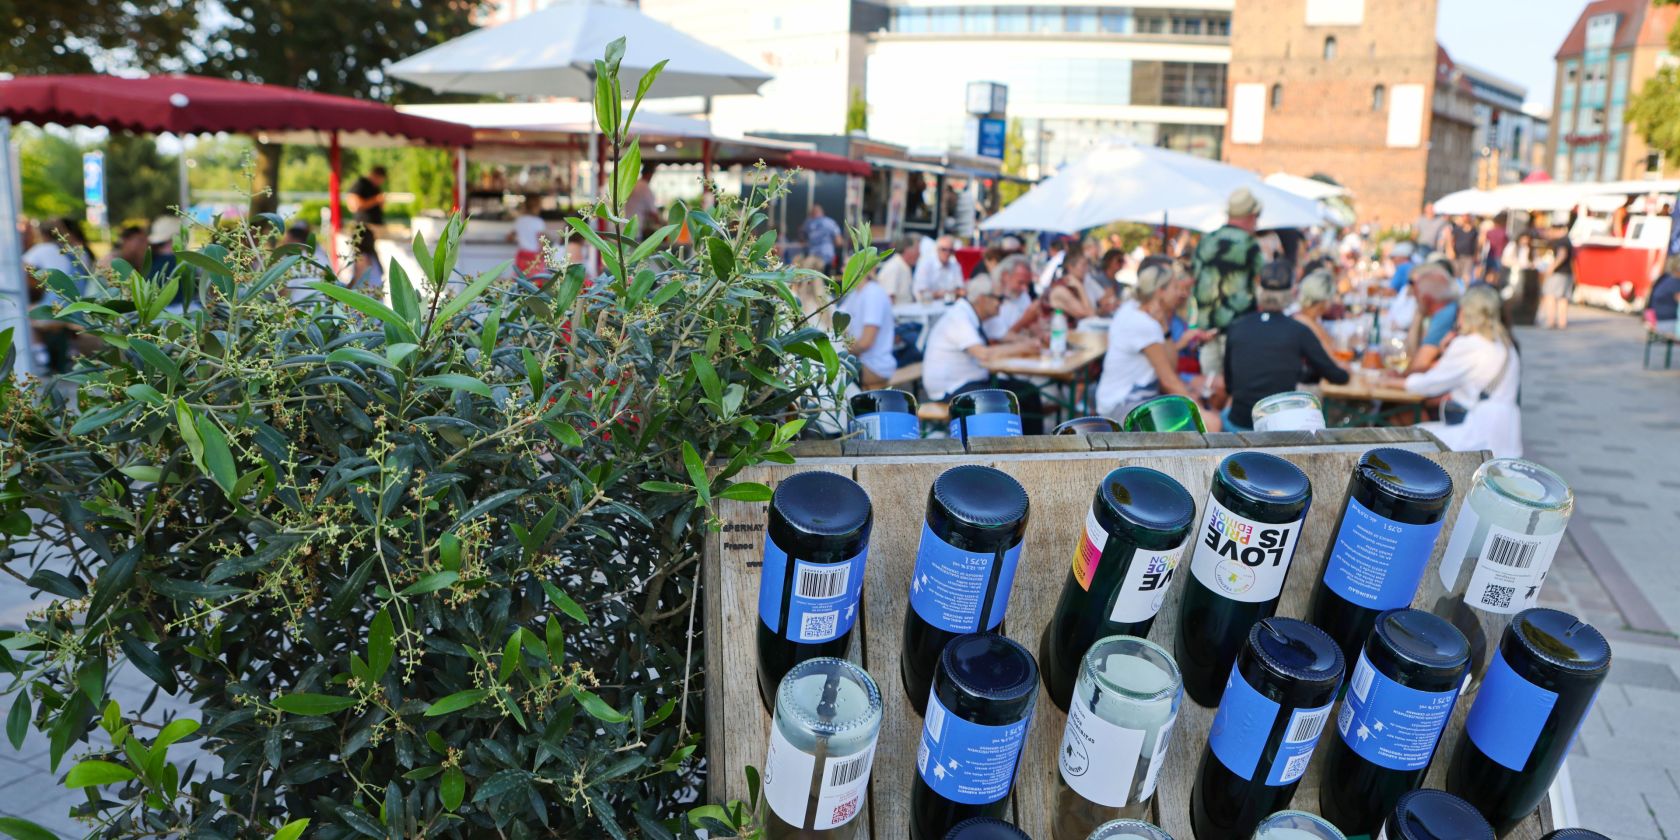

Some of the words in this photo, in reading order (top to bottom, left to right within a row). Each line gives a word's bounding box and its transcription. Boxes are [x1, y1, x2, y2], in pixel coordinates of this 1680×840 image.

[1210, 514, 1250, 544] PRIDE
[1212, 505, 1252, 533] EDITION
[1204, 524, 1284, 567] LOVE
[1258, 529, 1289, 548] IS
